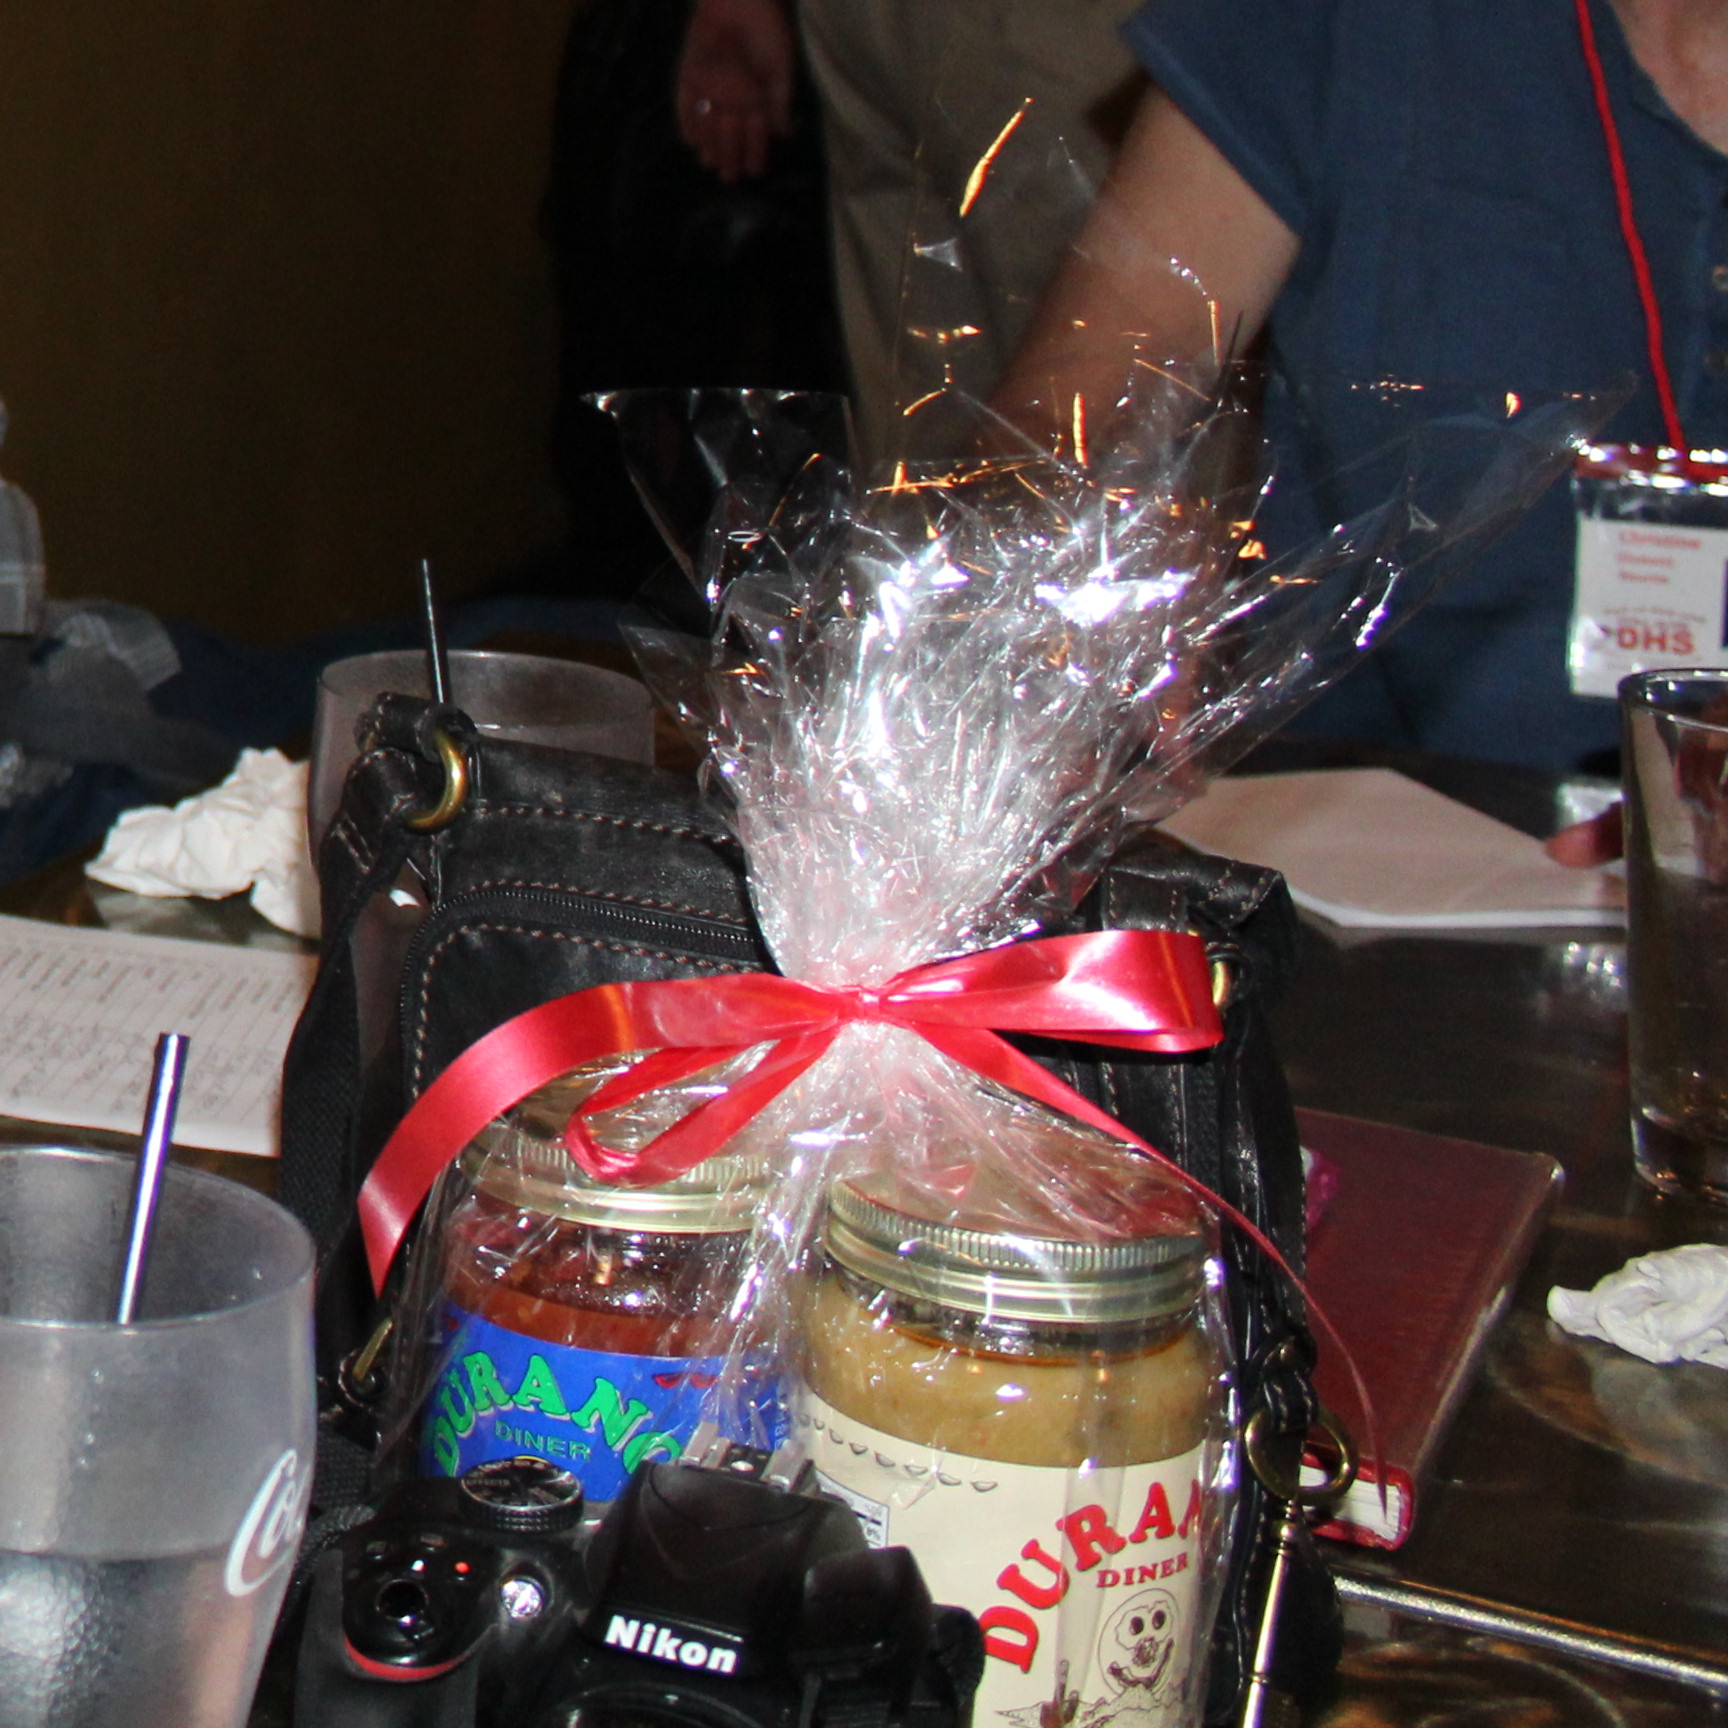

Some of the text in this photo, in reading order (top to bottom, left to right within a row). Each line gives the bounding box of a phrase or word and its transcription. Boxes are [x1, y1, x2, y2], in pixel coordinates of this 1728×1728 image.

[1616, 626, 1695, 655] DHS
[494, 1419, 591, 1461] DINER
[1096, 1552, 1189, 1589] DINER
[604, 1613, 737, 1673] Nikon
